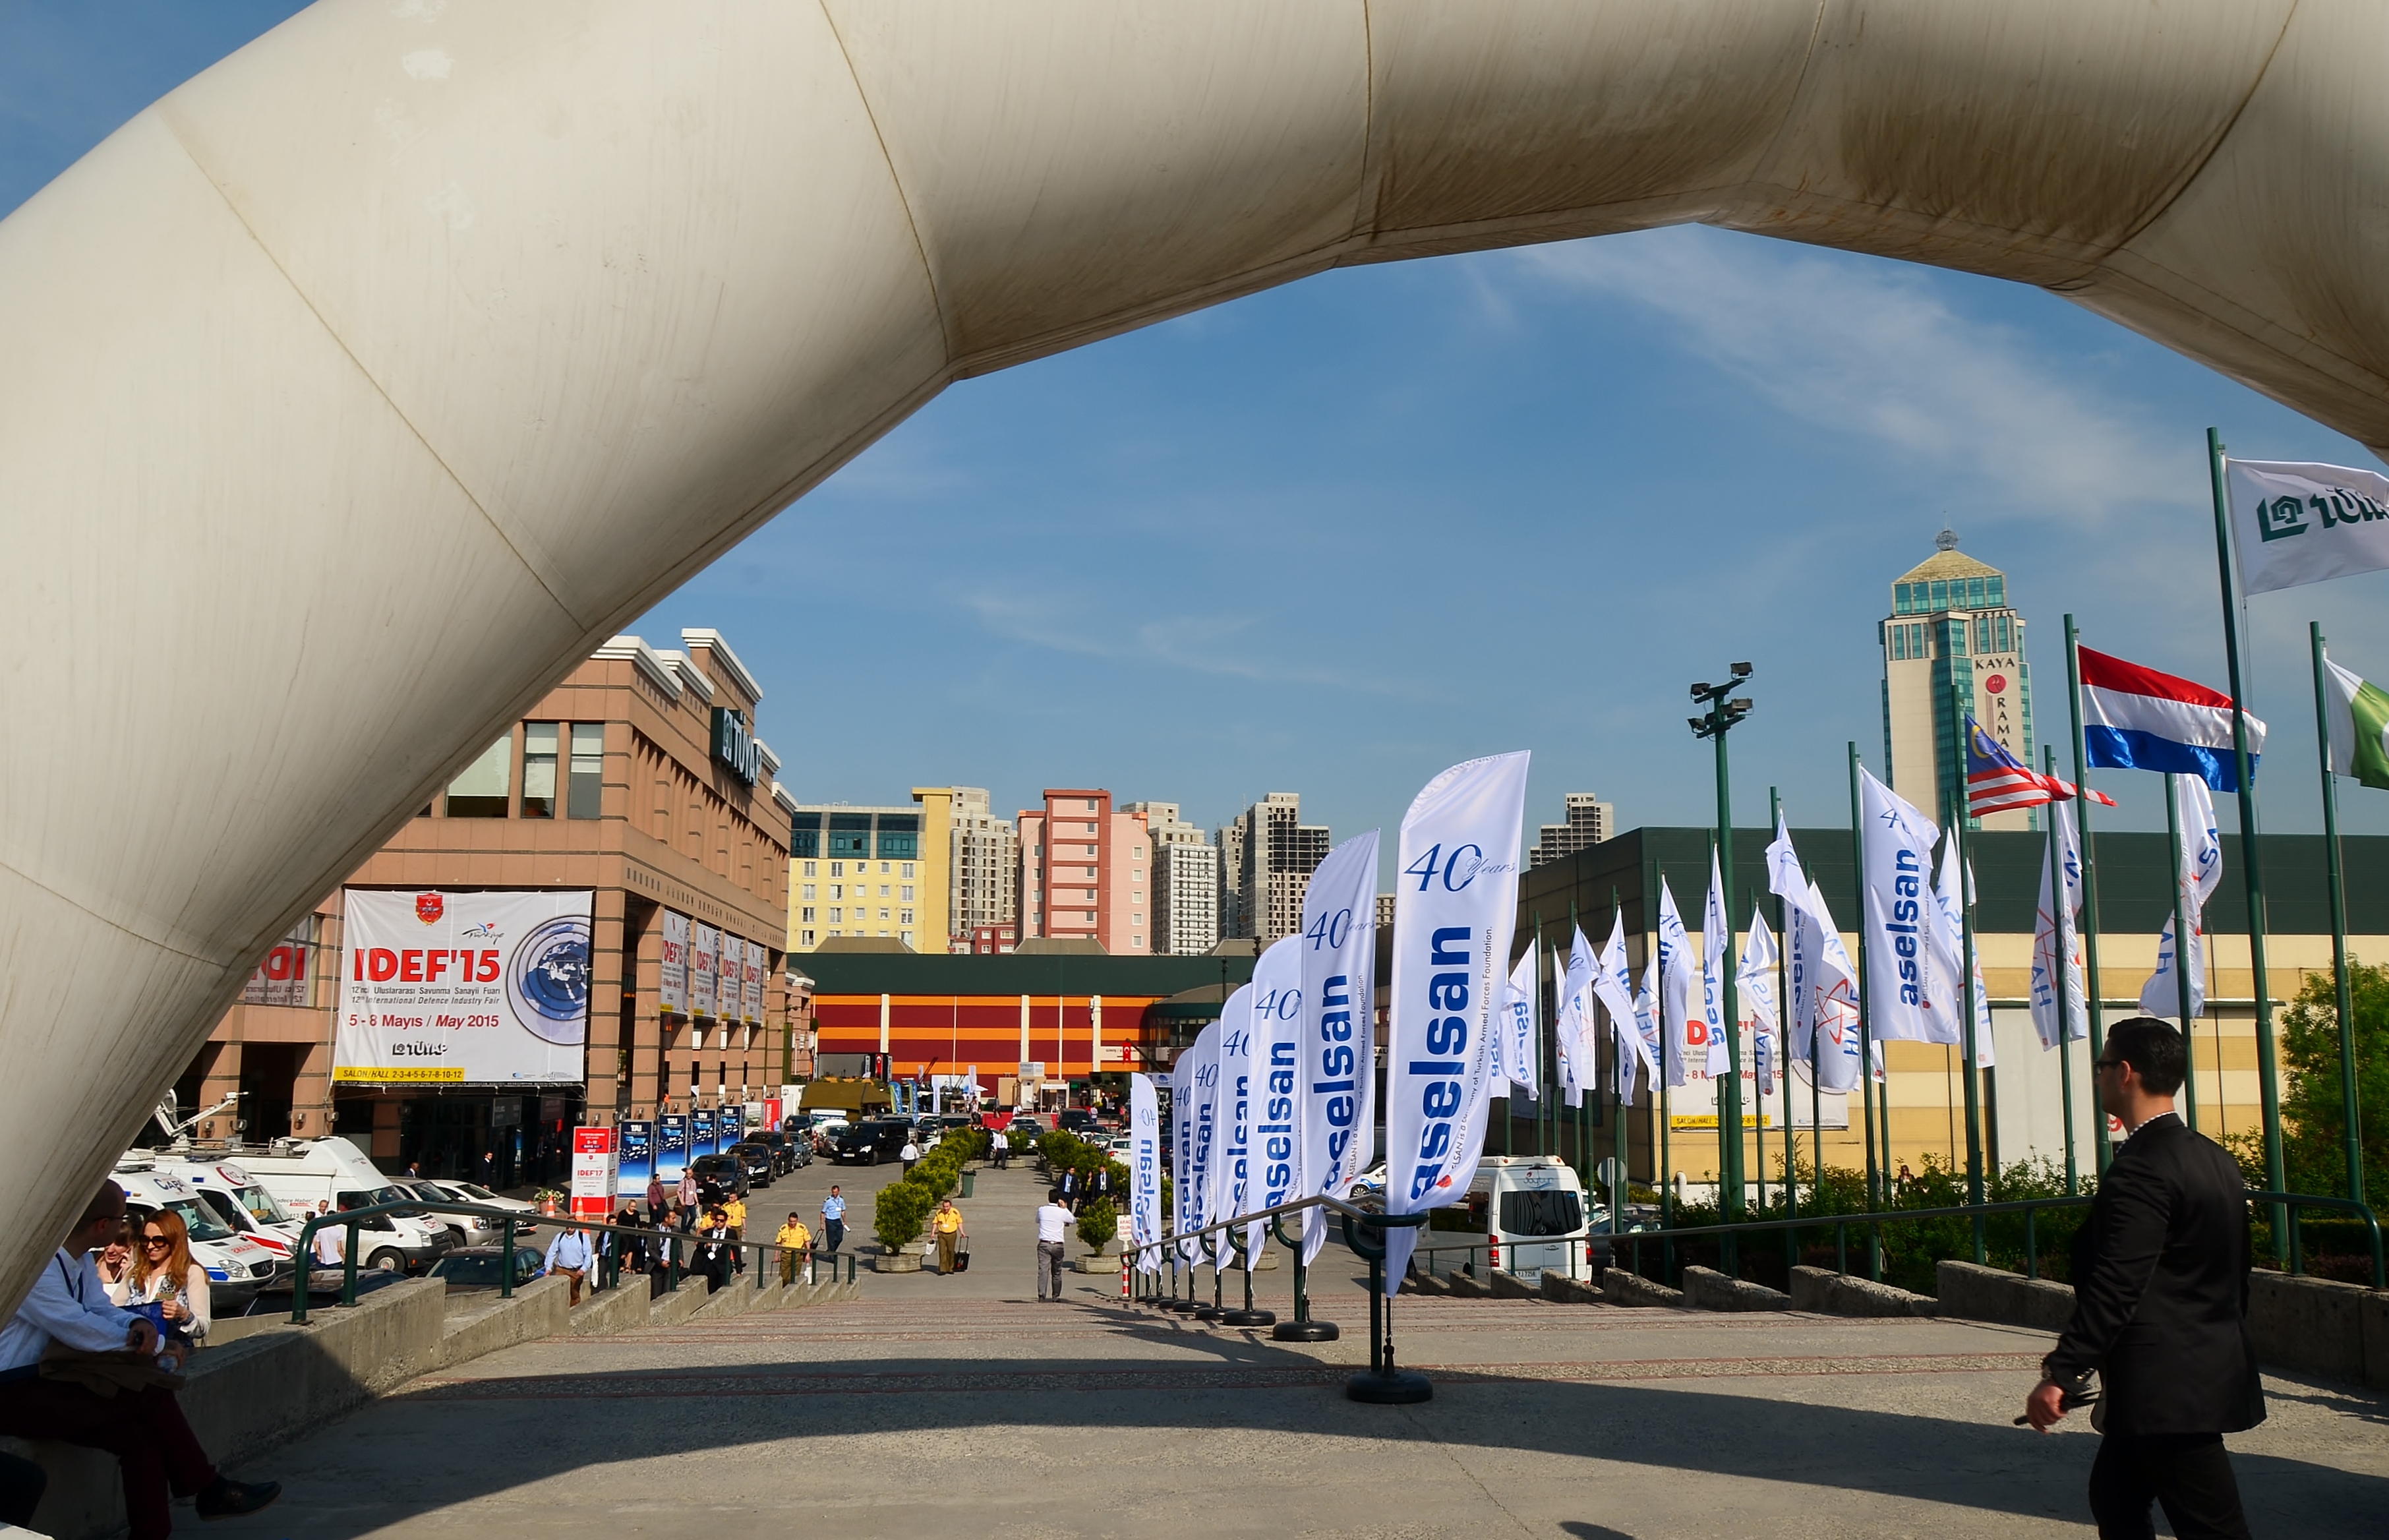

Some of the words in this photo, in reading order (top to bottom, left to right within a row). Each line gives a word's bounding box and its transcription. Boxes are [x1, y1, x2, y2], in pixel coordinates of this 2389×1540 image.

[1976, 658, 2015, 670] KAYA
[732, 711, 763, 786] TÜYAP
[1403, 843, 1482, 891] 40
[1461, 858, 1515, 880] Years
[461, 929, 505, 945] Türkiye
[1306, 908, 1351, 951] 40
[1886, 849, 1920, 1007] aselsan
[354, 947, 500, 982] IDEF'15
[1482, 926, 1492, 979] Foundation.
[451, 997, 482, 1006] Industry
[1255, 989, 1301, 1021] 40
[1481, 981, 1490, 1011] Forces
[349, 1015, 358, 1026] 5
[369, 1015, 377, 1026] 8
[382, 1015, 423, 1030] Mayıs
[435, 1015, 465, 1030] May
[467, 1015, 499, 1027] 2015
[1480, 1013, 1489, 1043] Armed
[406, 1040, 448, 1056] TÜYAP
[1408, 927, 1471, 1200] aselsan
[1475, 1047, 1485, 1076] Turkish
[343, 1069, 390, 1078] SALON/HALL
[392, 1070, 462, 1079] 2-3-4-5-6-7-8-10-12
[1195, 1063, 1218, 1087] 40
[1312, 975, 1354, 1190] aselsan
[1257, 1042, 1295, 1210] aselsan
